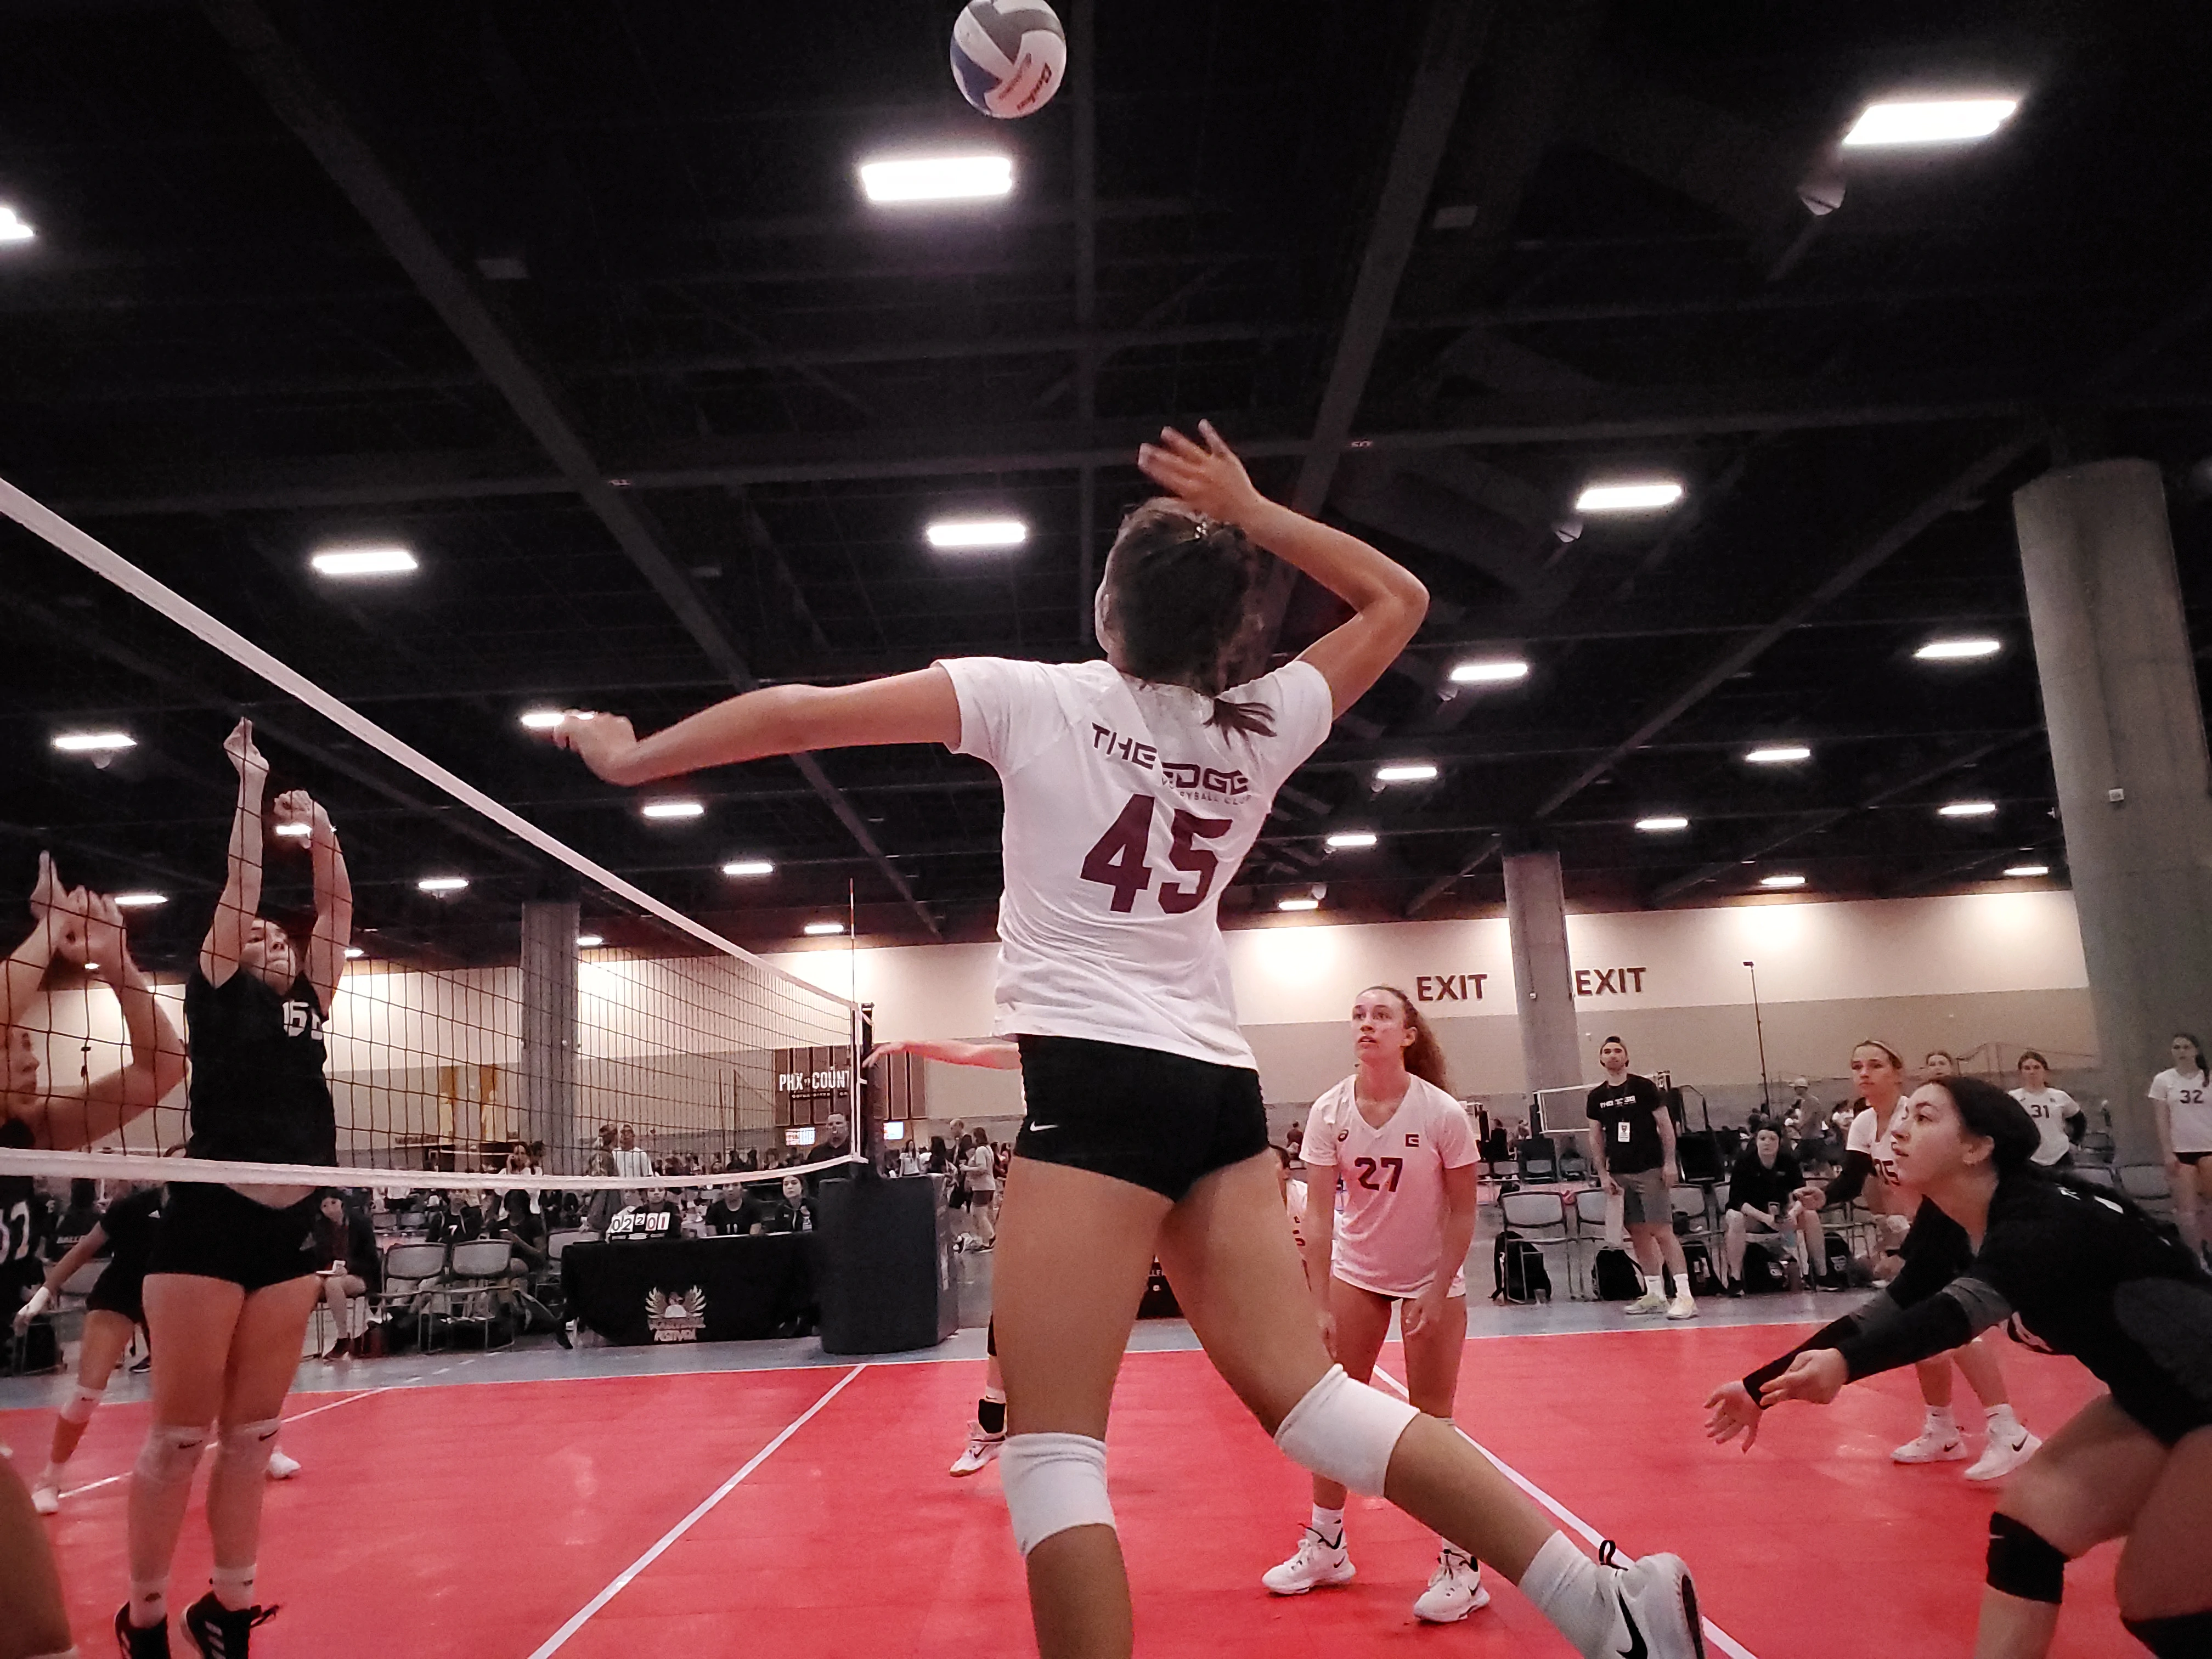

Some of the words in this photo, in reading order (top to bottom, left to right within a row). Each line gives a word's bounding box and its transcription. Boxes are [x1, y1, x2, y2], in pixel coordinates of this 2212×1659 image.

[1092, 722, 1157, 770] THE
[1080, 793, 1233, 914] 45
[1416, 974, 1488, 1001] EXIT
[1575, 967, 1646, 996] EXIT
[2180, 1089, 2204, 1104] 32
[2030, 1104, 2050, 1119] 31
[1354, 1156, 1403, 1193] 27
[449, 1224, 459, 1237] 7
[612, 1218, 633, 1232] 02
[637, 1216, 644, 1224] 2
[647, 1216, 667, 1230] 01
